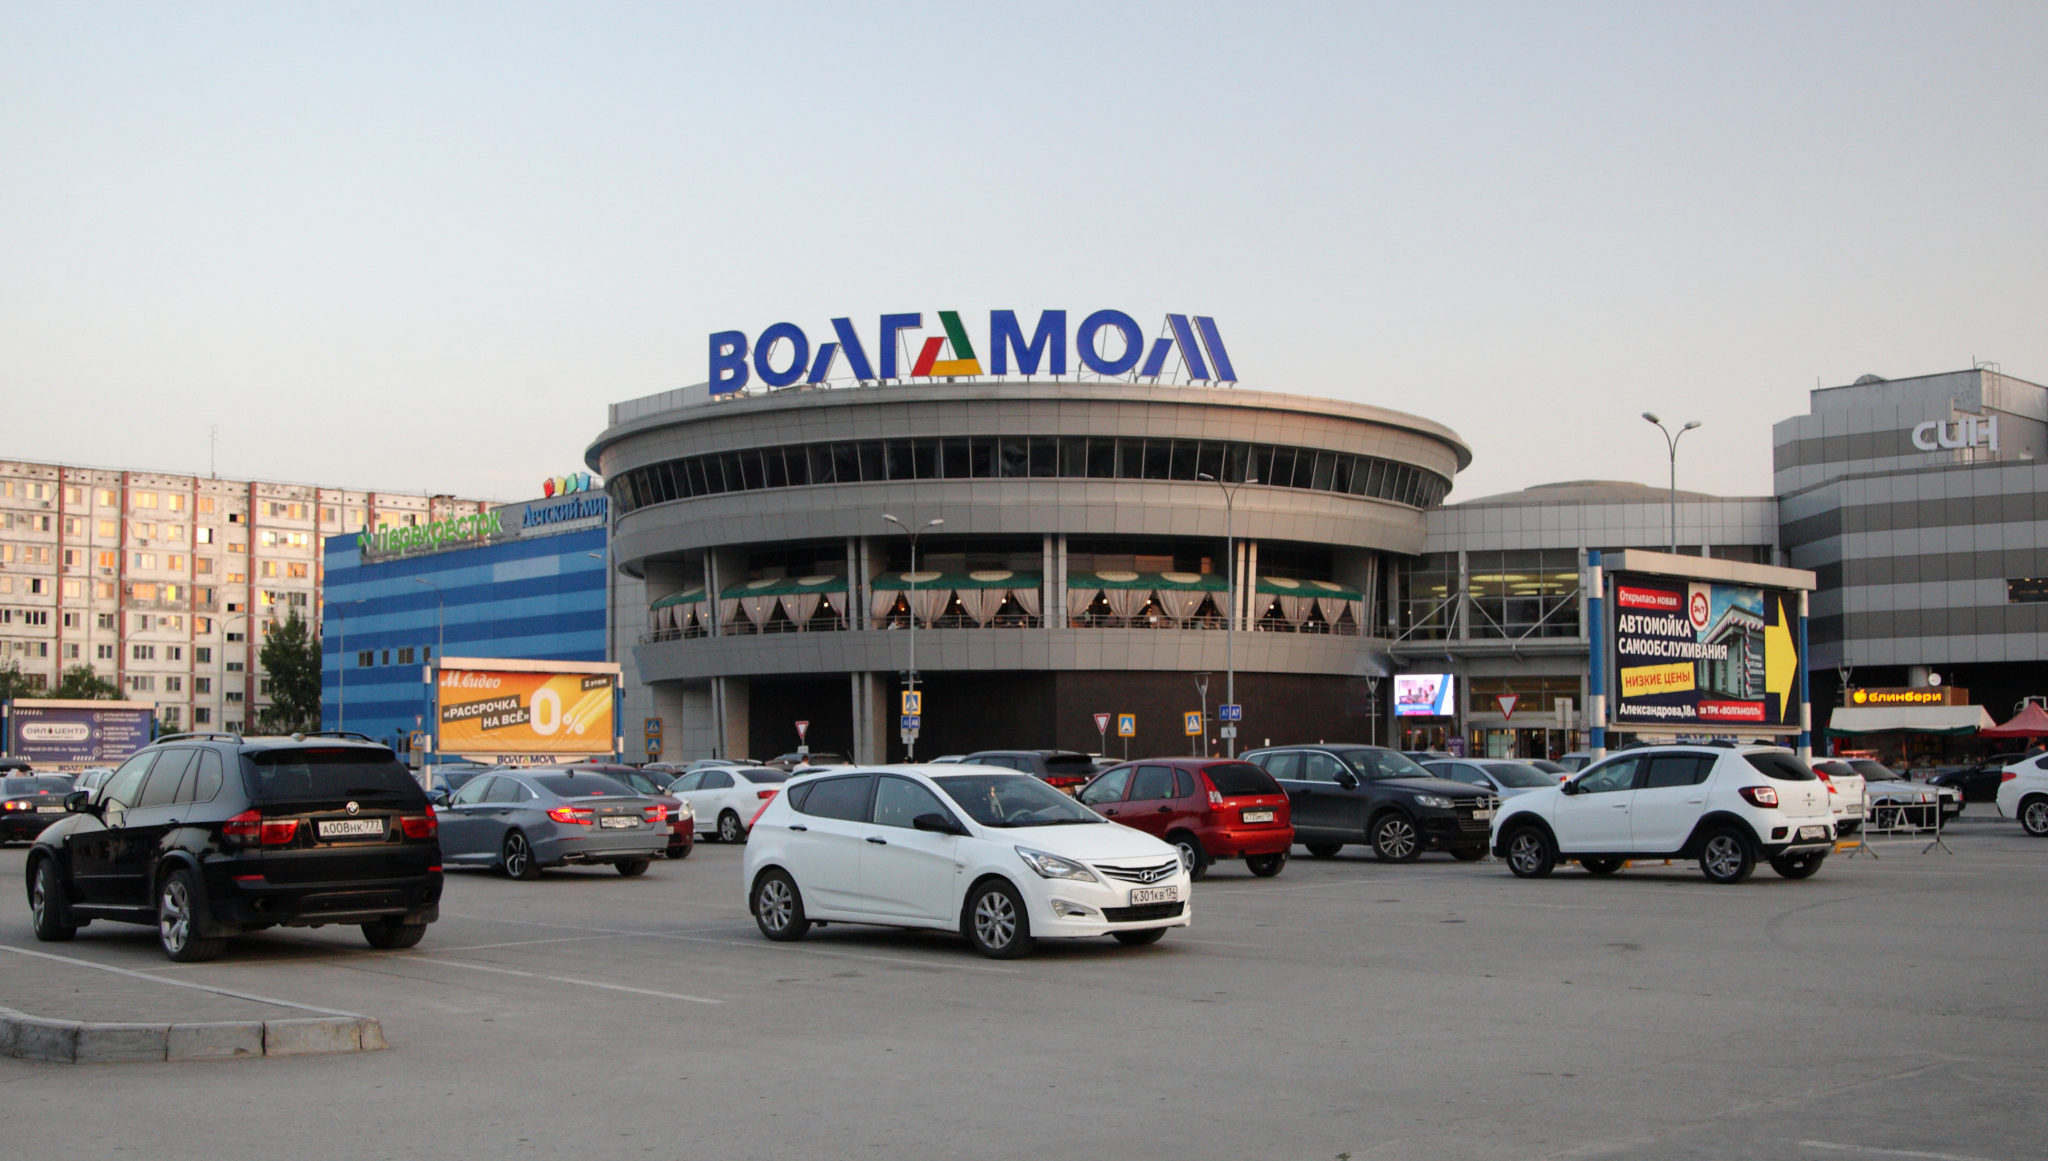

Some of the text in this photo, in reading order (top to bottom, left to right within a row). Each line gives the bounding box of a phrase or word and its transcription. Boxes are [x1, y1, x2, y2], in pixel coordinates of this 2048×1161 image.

[522, 496, 580, 529] Детский
[377, 510, 502, 555] Перекрёсток
[1619, 589, 1677, 606] Открылась новая
[1619, 614, 1692, 638] АВТОМОЙКА
[1618, 636, 1728, 660] САМООБСЛУЖИВАНИЯ
[1625, 670, 1690, 688] НИЗКИЕ ЦЕНЫ
[1869, 691, 1942, 704] блинбери
[443, 698, 517, 718] «РАССРОЧКА
[1707, 705, 1719, 715] ТРК
[483, 709, 529, 728] НА ВСЁ»
[54, 727, 86, 735] ЦЕНТР
